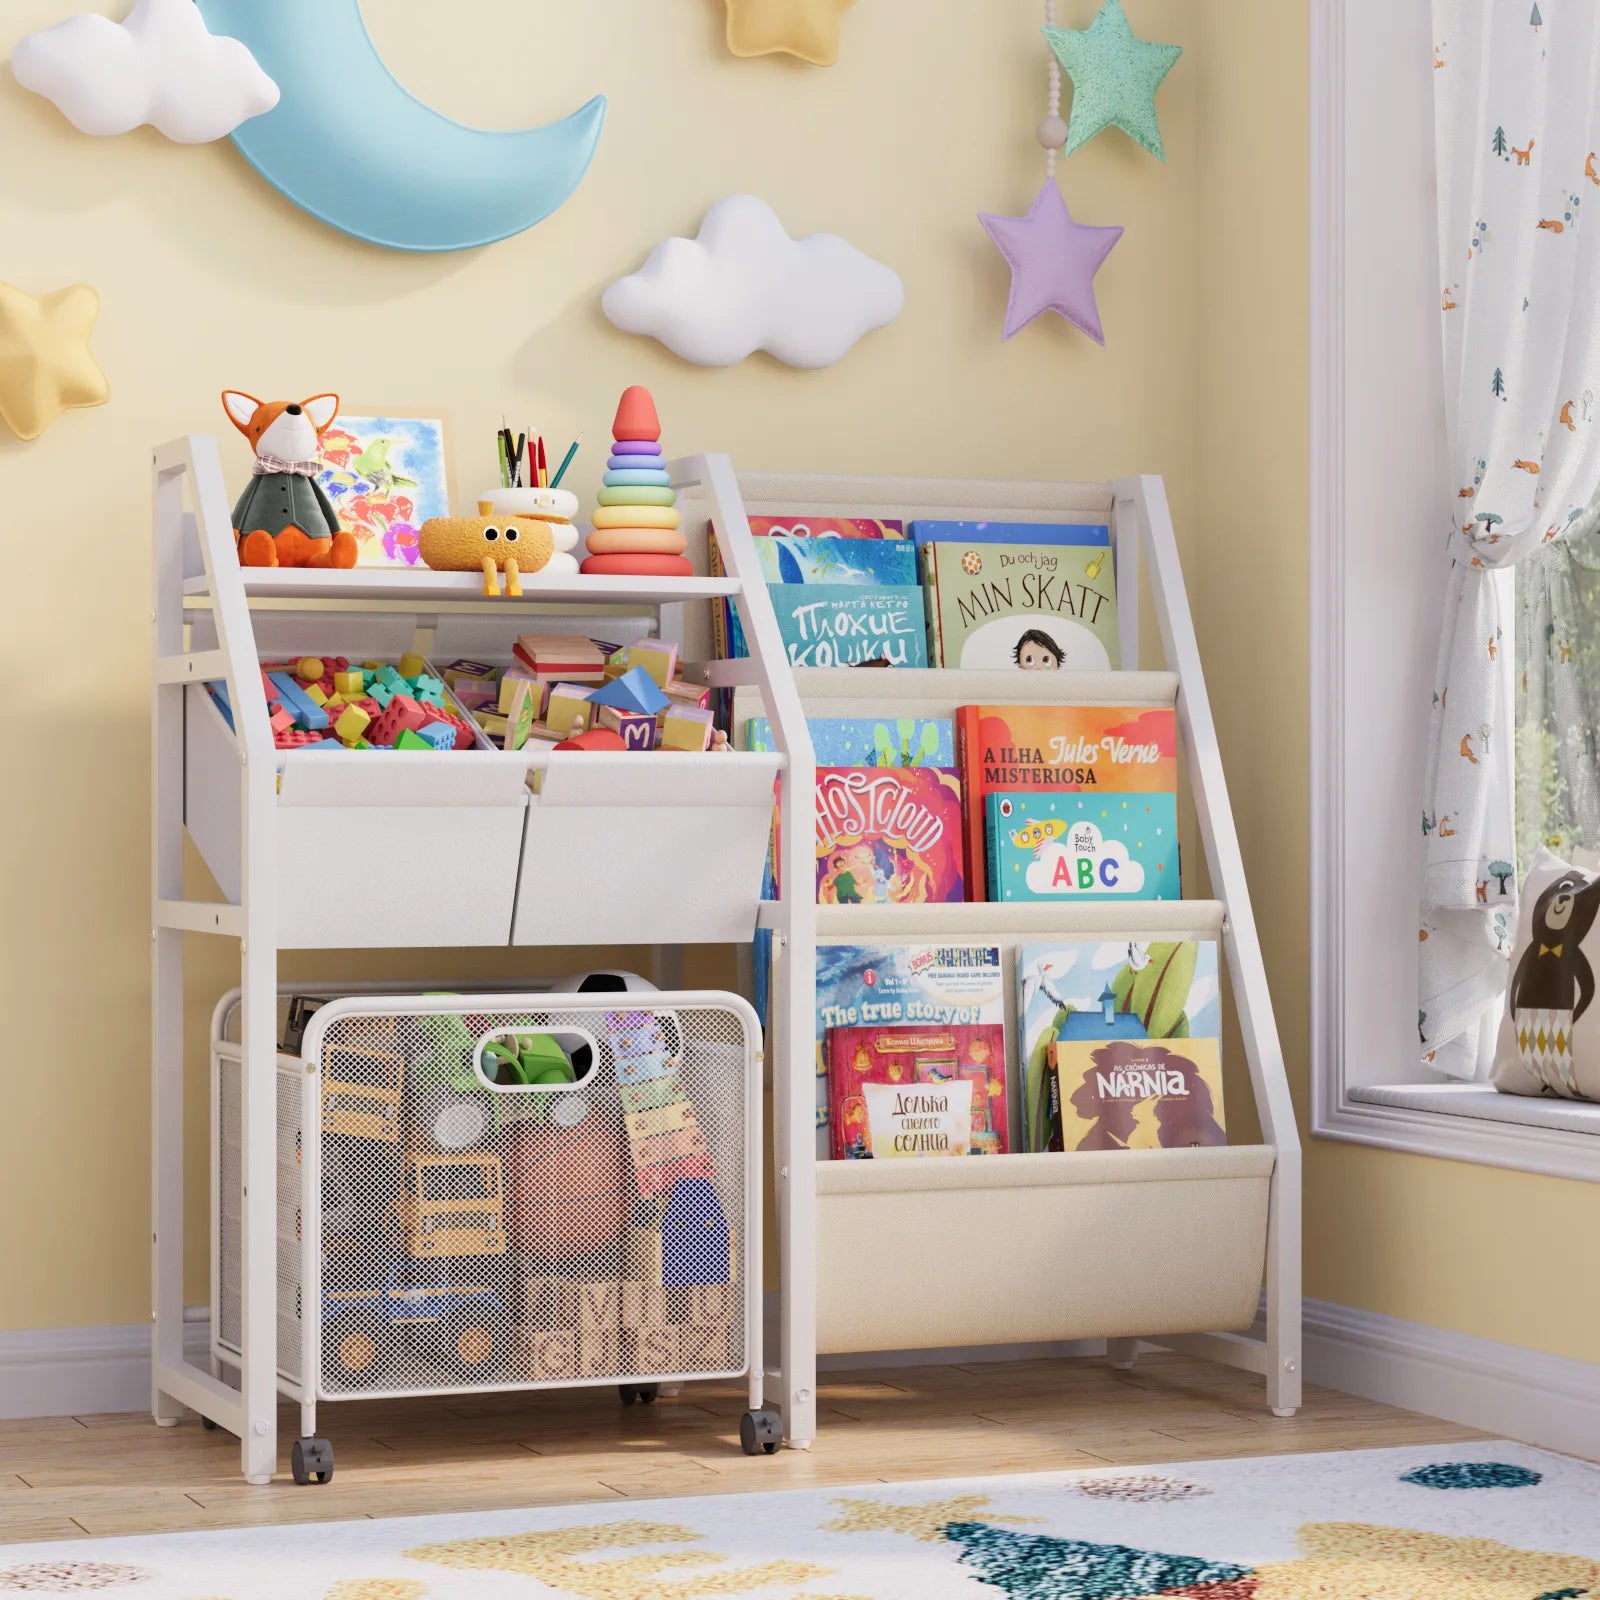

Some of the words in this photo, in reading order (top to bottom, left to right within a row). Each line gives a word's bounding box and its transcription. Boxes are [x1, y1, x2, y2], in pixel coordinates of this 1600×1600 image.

[1000, 554, 1015, 568] Du
[1018, 552, 1036, 564] och
[1035, 553, 1058, 571] jag
[957, 578, 1013, 628] MIN
[1022, 573, 1109, 625] SKATT
[624, 722, 650, 749] M
[983, 748, 995, 763] A
[1000, 748, 1044, 764] ILHA
[1048, 736, 1100, 765] Jules
[1101, 736, 1160, 765] Verne
[985, 768, 1097, 784] MISTERIOSA
[815, 772, 944, 853] HOSTCLOUD
[1075, 833, 1094, 846] Baby
[1075, 843, 1096, 853] Touch
[1052, 855, 1120, 889] ABC
[911, 951, 934, 970] BONUS
[821, 1005, 857, 1028] The
[861, 999, 901, 1021] true
[905, 999, 955, 1023] story
[957, 1006, 980, 1024] of
[1125, 1062, 1156, 1071] CRÔNICAS
[892, 1093, 949, 1116] Долька
[901, 1117, 940, 1130] спелого
[894, 1132, 949, 1152] солнца
